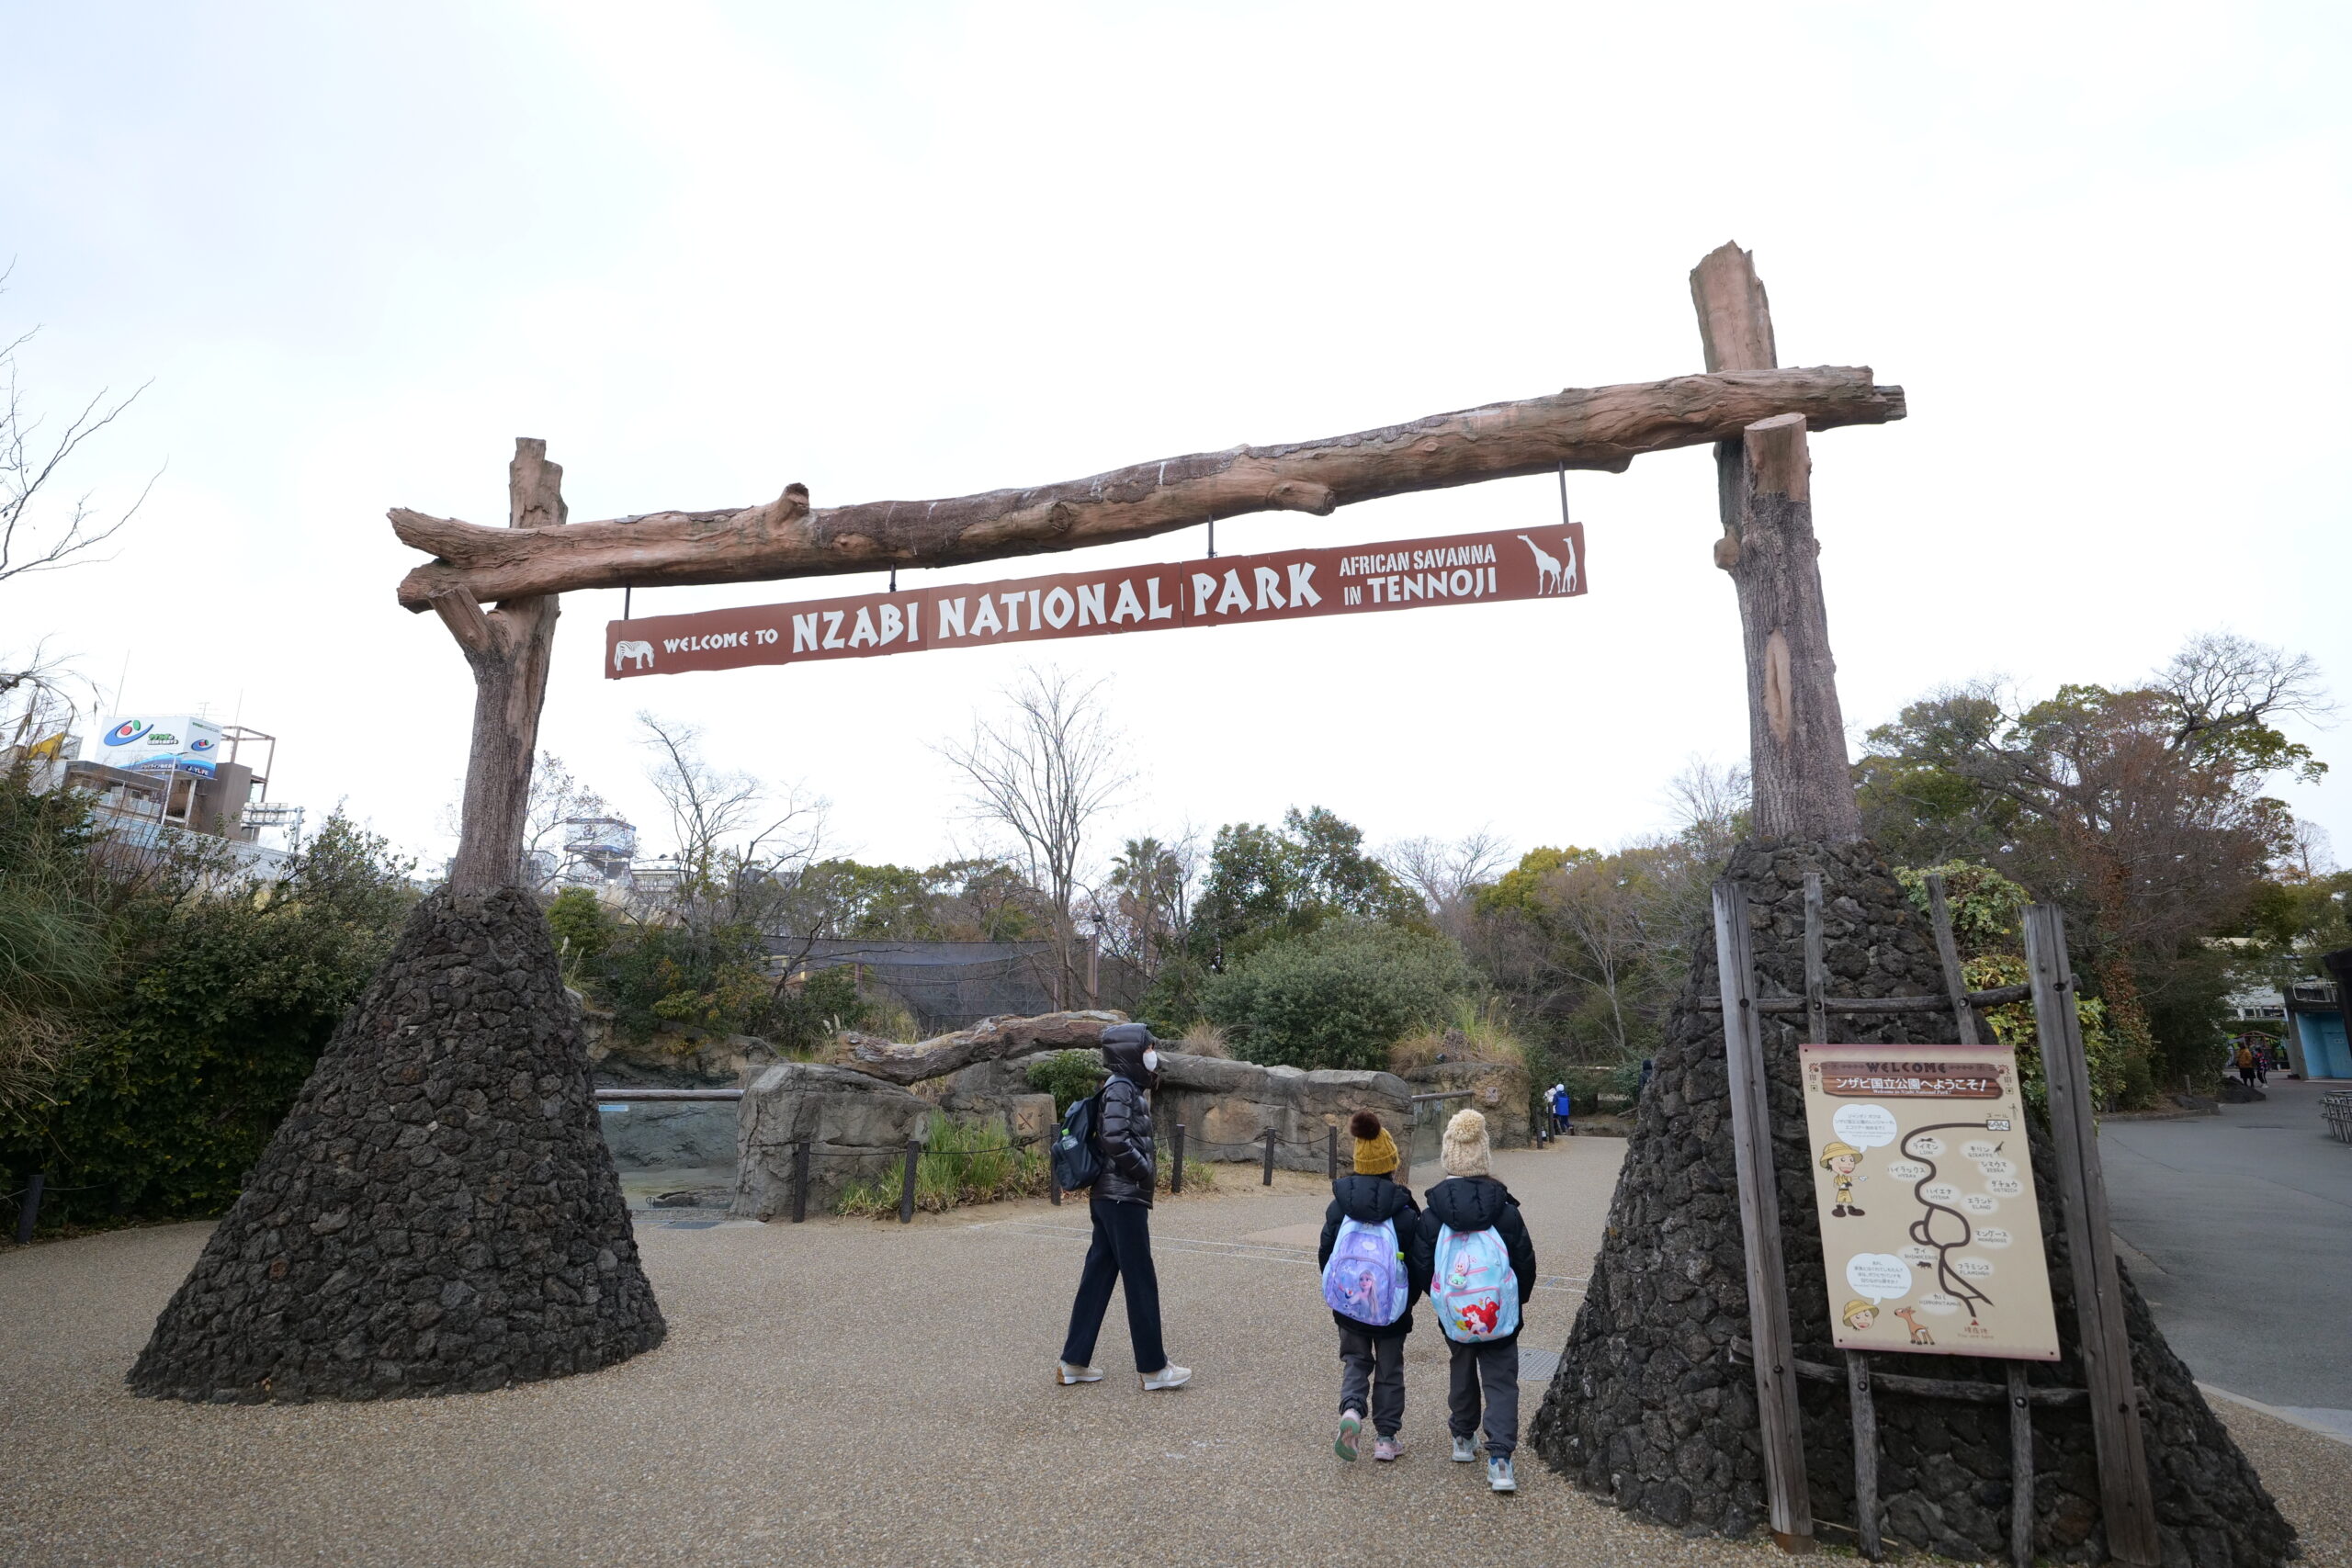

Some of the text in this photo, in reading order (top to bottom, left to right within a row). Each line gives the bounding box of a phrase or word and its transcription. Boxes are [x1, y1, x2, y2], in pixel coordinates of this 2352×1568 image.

[1339, 543, 1497, 577] AFRICAN SAVANNA
[1344, 566, 1497, 606] IN TENNOJI
[663, 561, 1323, 654] WELCOME TO NZABI NATIONAL PARK
[1865, 1062, 1947, 1074] WELCOME
[1912, 1142, 1939, 1150] ライオン
[1991, 1179, 2018, 1188] ダチョウ
